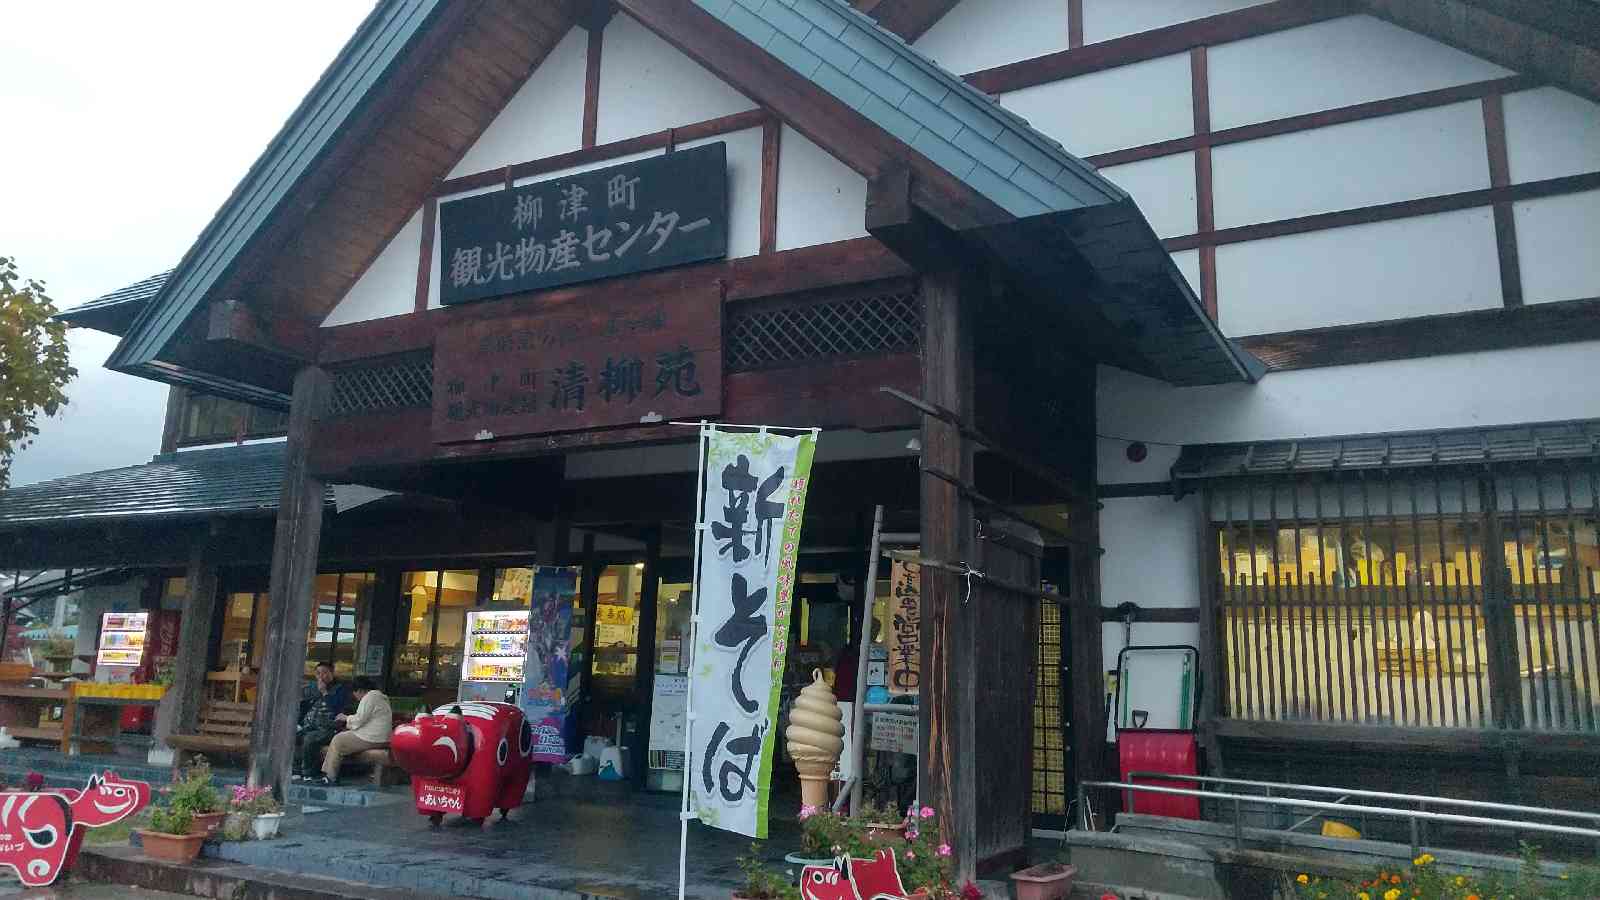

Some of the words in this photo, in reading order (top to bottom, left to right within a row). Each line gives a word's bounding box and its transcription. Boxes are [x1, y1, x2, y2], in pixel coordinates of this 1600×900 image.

[512, 173, 641, 230] 柳津町
[449, 210, 711, 287] 観光物産センター
[549, 345, 701, 412] 清柳苑
[701, 454, 786, 803] 新そば
[424, 793, 462, 810] あいちゃん
